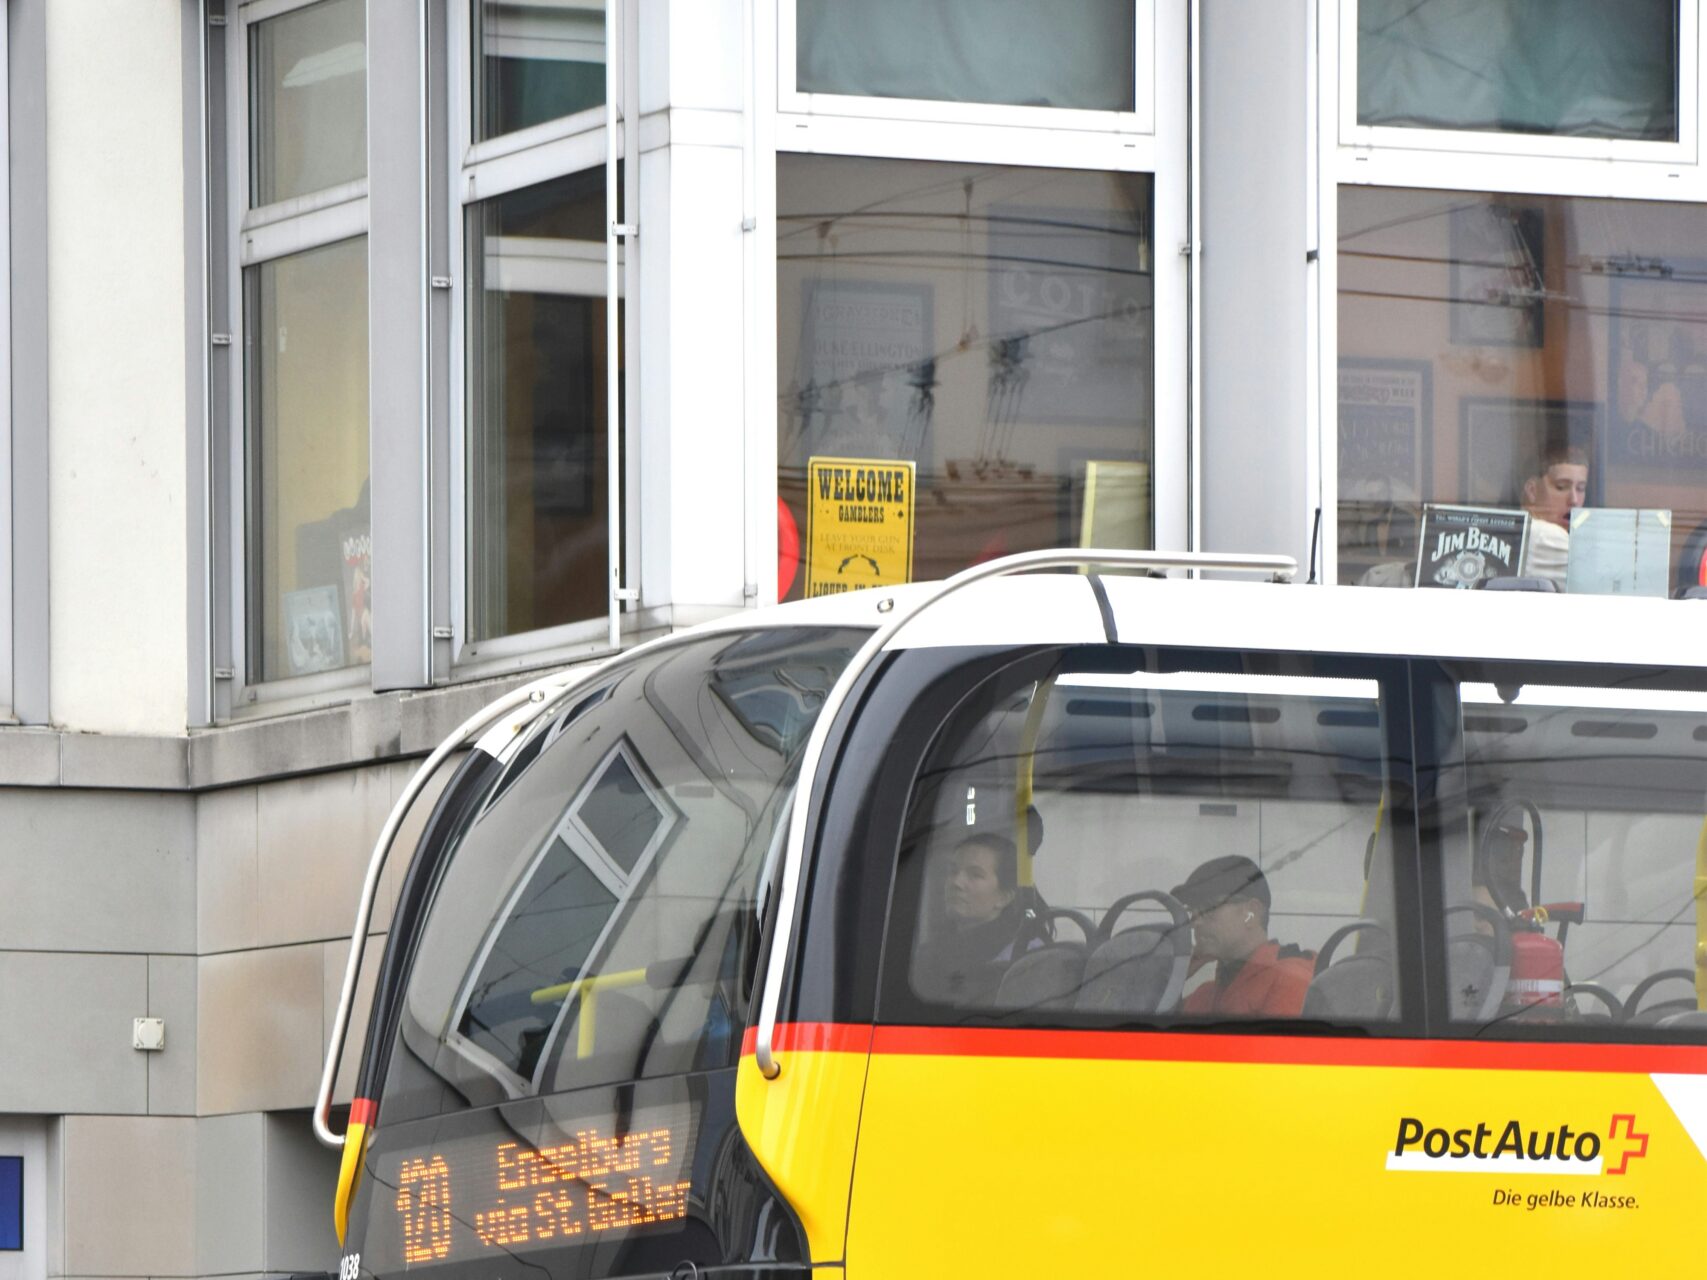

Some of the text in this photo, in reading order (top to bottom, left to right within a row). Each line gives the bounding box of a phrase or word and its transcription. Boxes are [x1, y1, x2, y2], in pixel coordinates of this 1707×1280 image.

[818, 468, 904, 503] WELCOME
[838, 505, 885, 524] GAMBLERS
[1431, 526, 1512, 568] JIM BEAM
[496, 1127, 672, 1191] Engelburg
[1394, 1116, 1601, 1163] PostAuto
[1492, 1189, 1641, 1211] Die gelbe Klasse.
[475, 1196, 530, 1248] via
